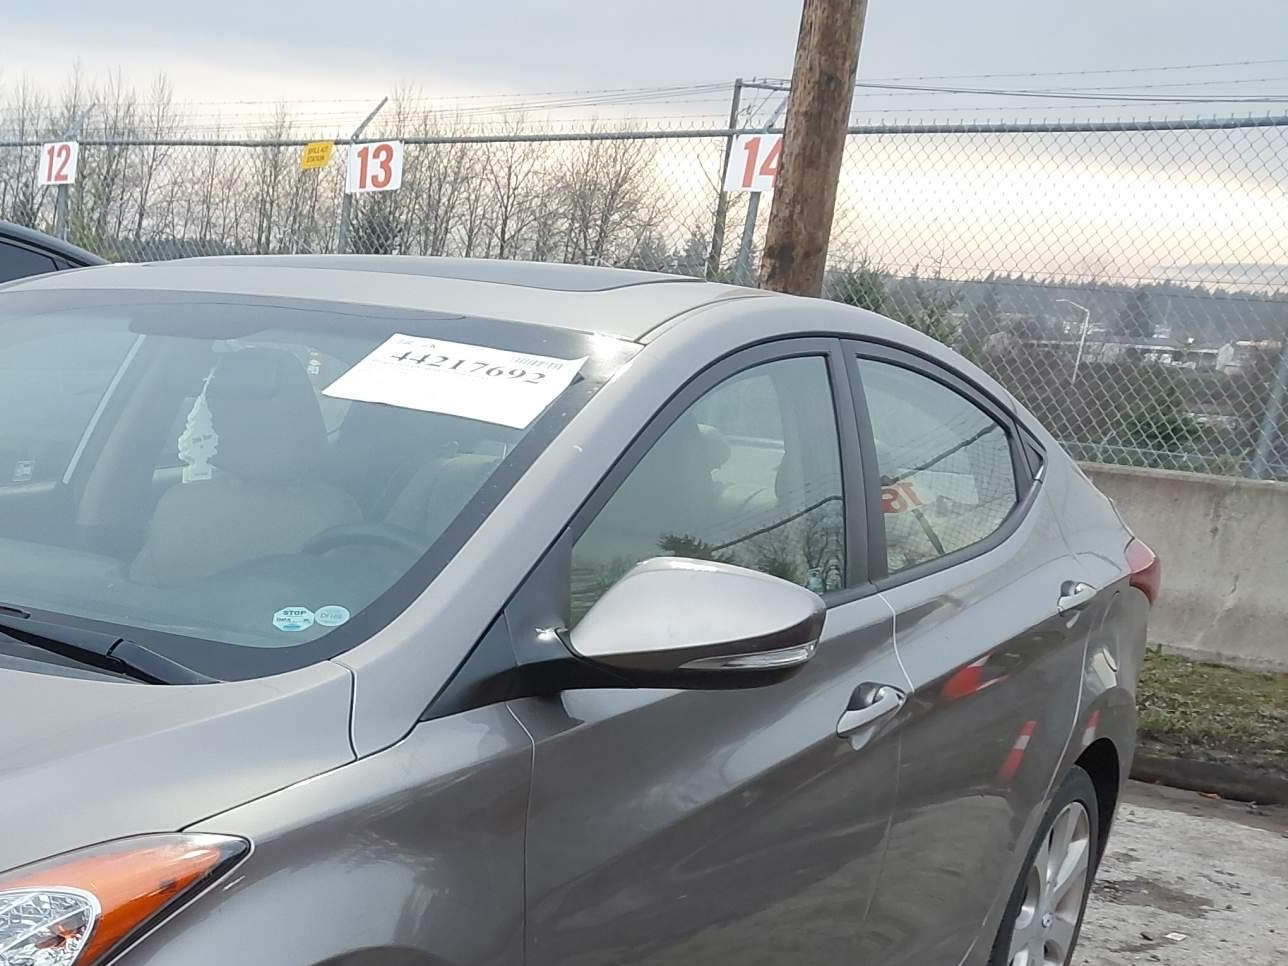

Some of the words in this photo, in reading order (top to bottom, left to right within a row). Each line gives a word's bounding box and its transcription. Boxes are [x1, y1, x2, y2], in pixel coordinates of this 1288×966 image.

[46, 143, 71, 182] 12
[357, 143, 394, 189] 13
[742, 136, 783, 188] 14
[391, 351, 546, 385] 44217692
